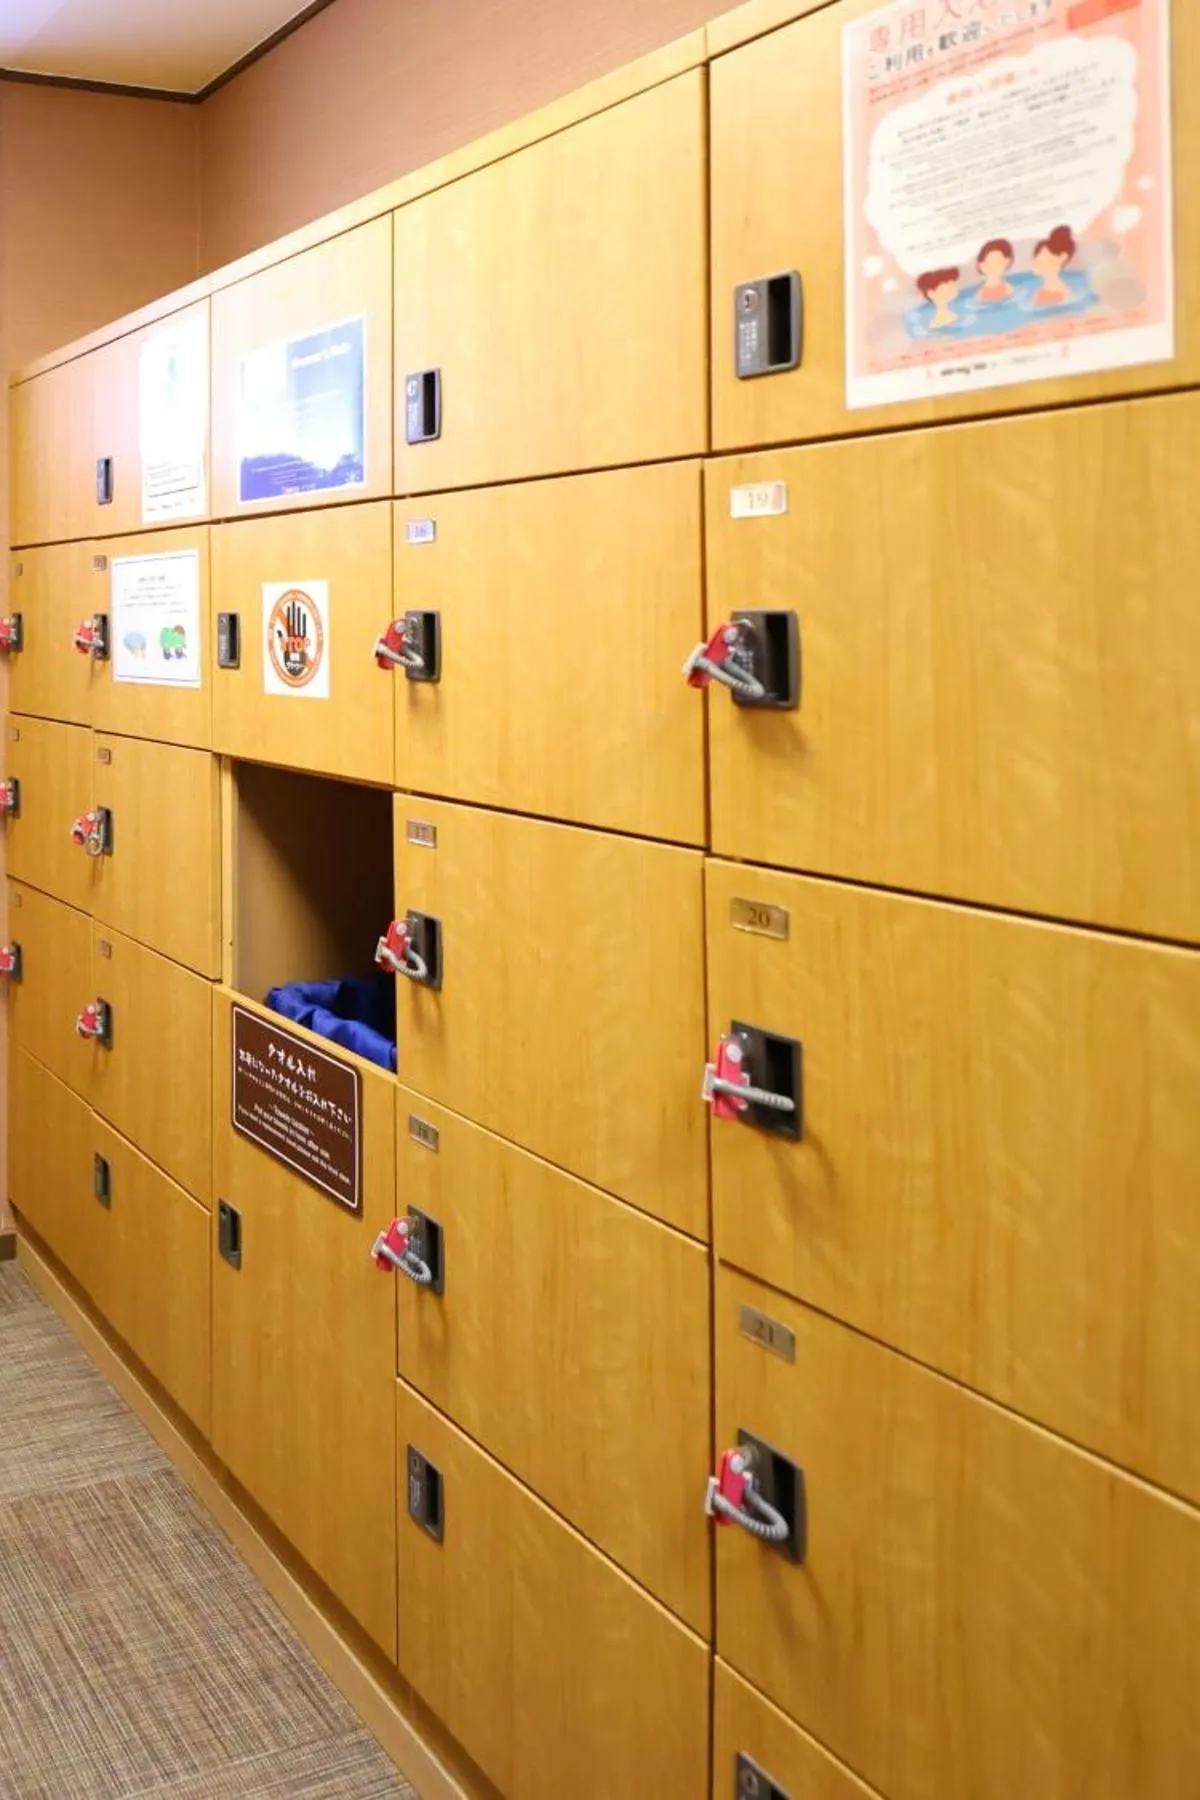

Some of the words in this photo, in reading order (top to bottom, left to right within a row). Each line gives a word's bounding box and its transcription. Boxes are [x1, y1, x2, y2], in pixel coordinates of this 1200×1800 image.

[748, 491, 769, 509] 19
[748, 906, 770, 928] 20
[268, 1042, 316, 1082] タオル入れ
